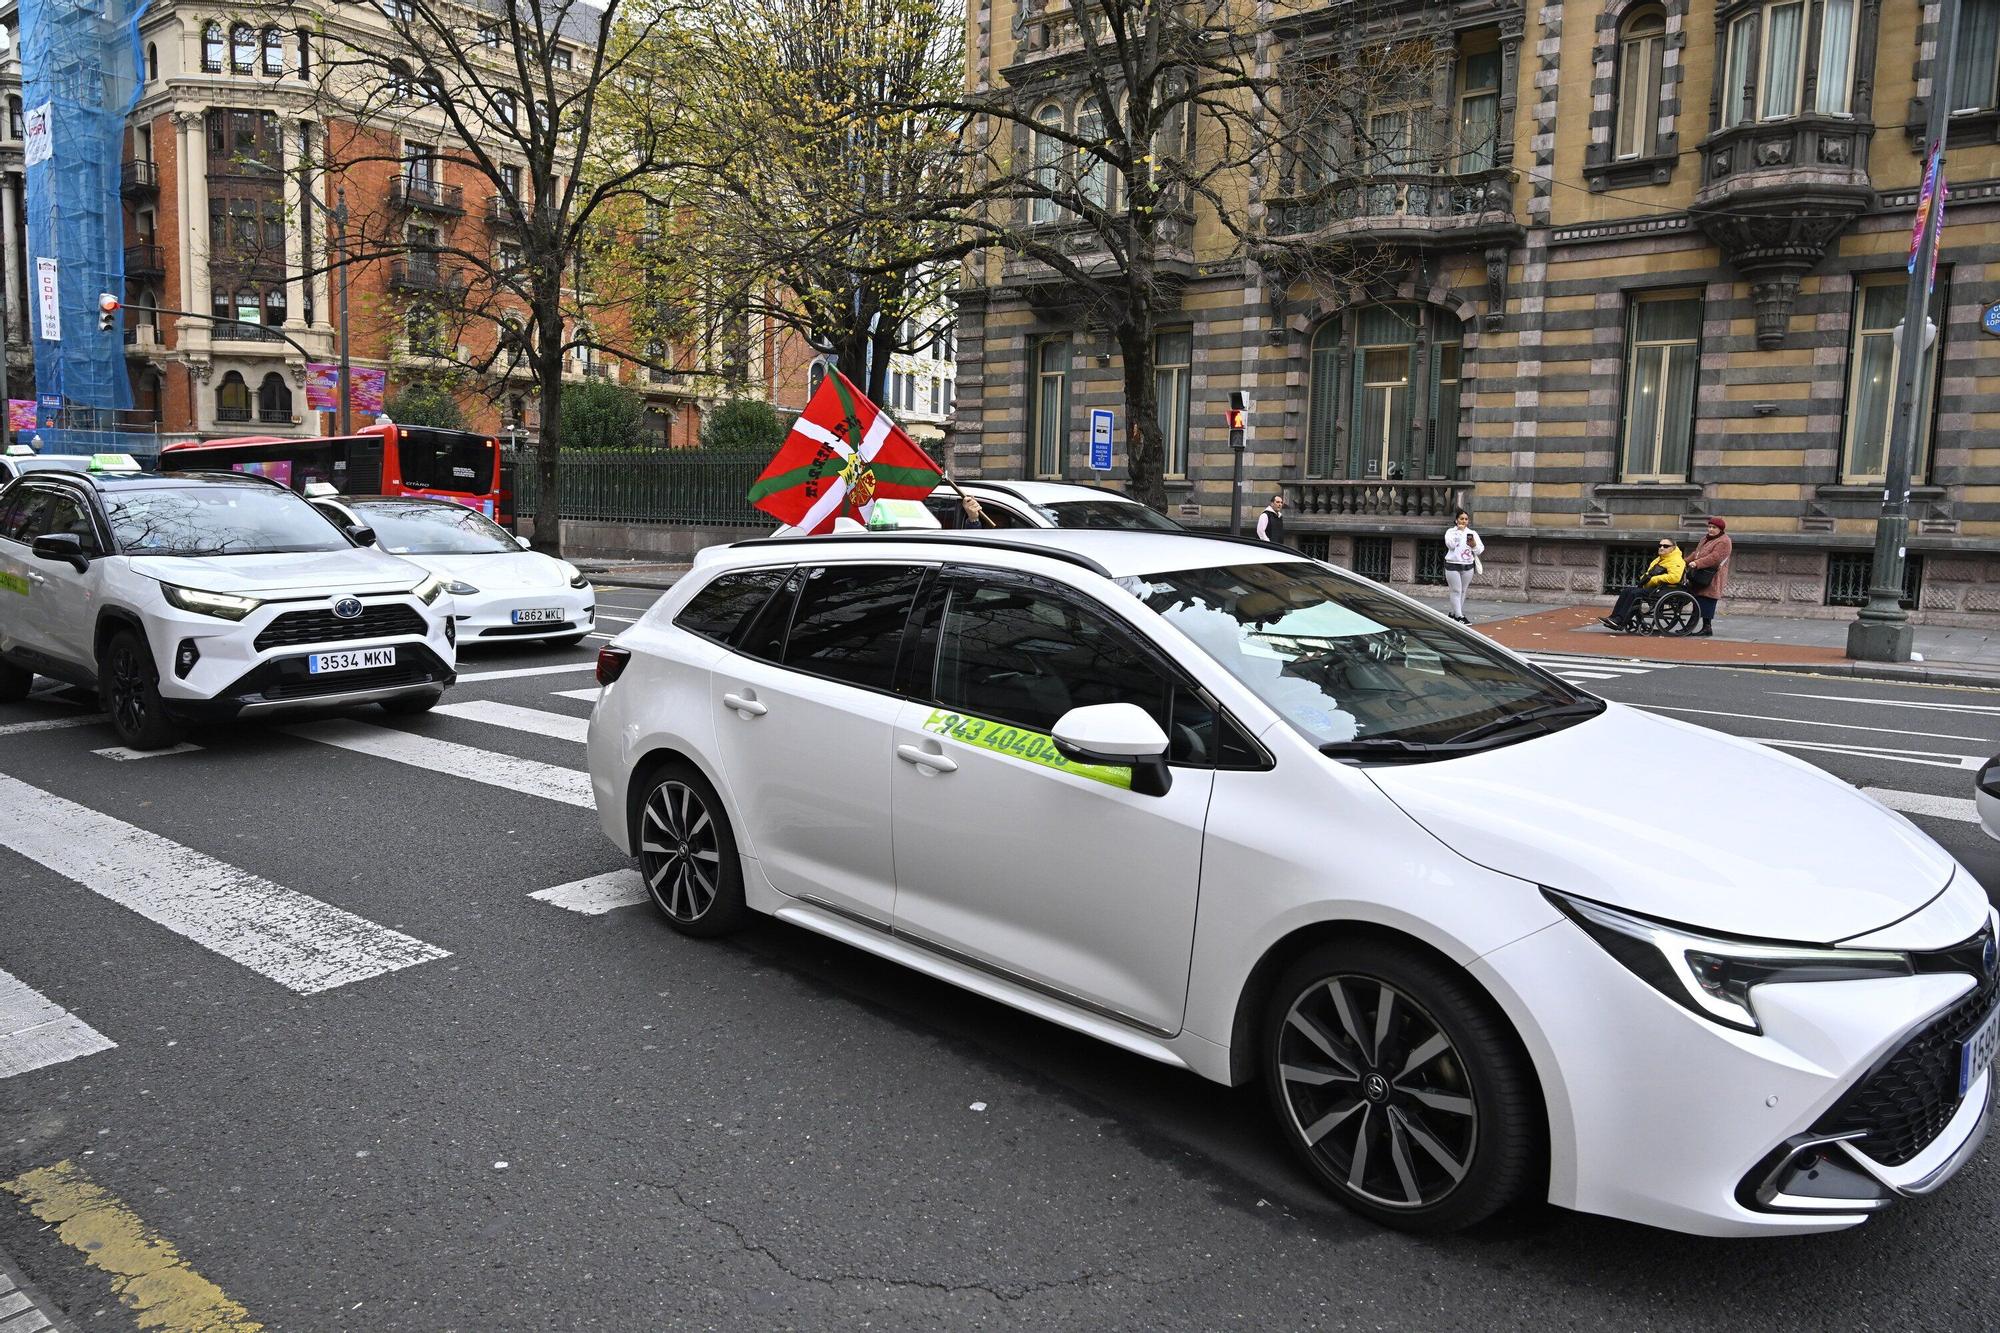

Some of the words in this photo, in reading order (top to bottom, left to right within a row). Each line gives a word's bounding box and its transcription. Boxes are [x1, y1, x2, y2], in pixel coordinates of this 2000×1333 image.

[306, 378, 337, 388] Saturday
[518, 610, 543, 621] 4862
[545, 609, 561, 620] MKL
[320, 653, 359, 670] 3534
[364, 650, 392, 666] MKN
[942, 714, 986, 740] 943
[1972, 1017, 1997, 1079] 1599
